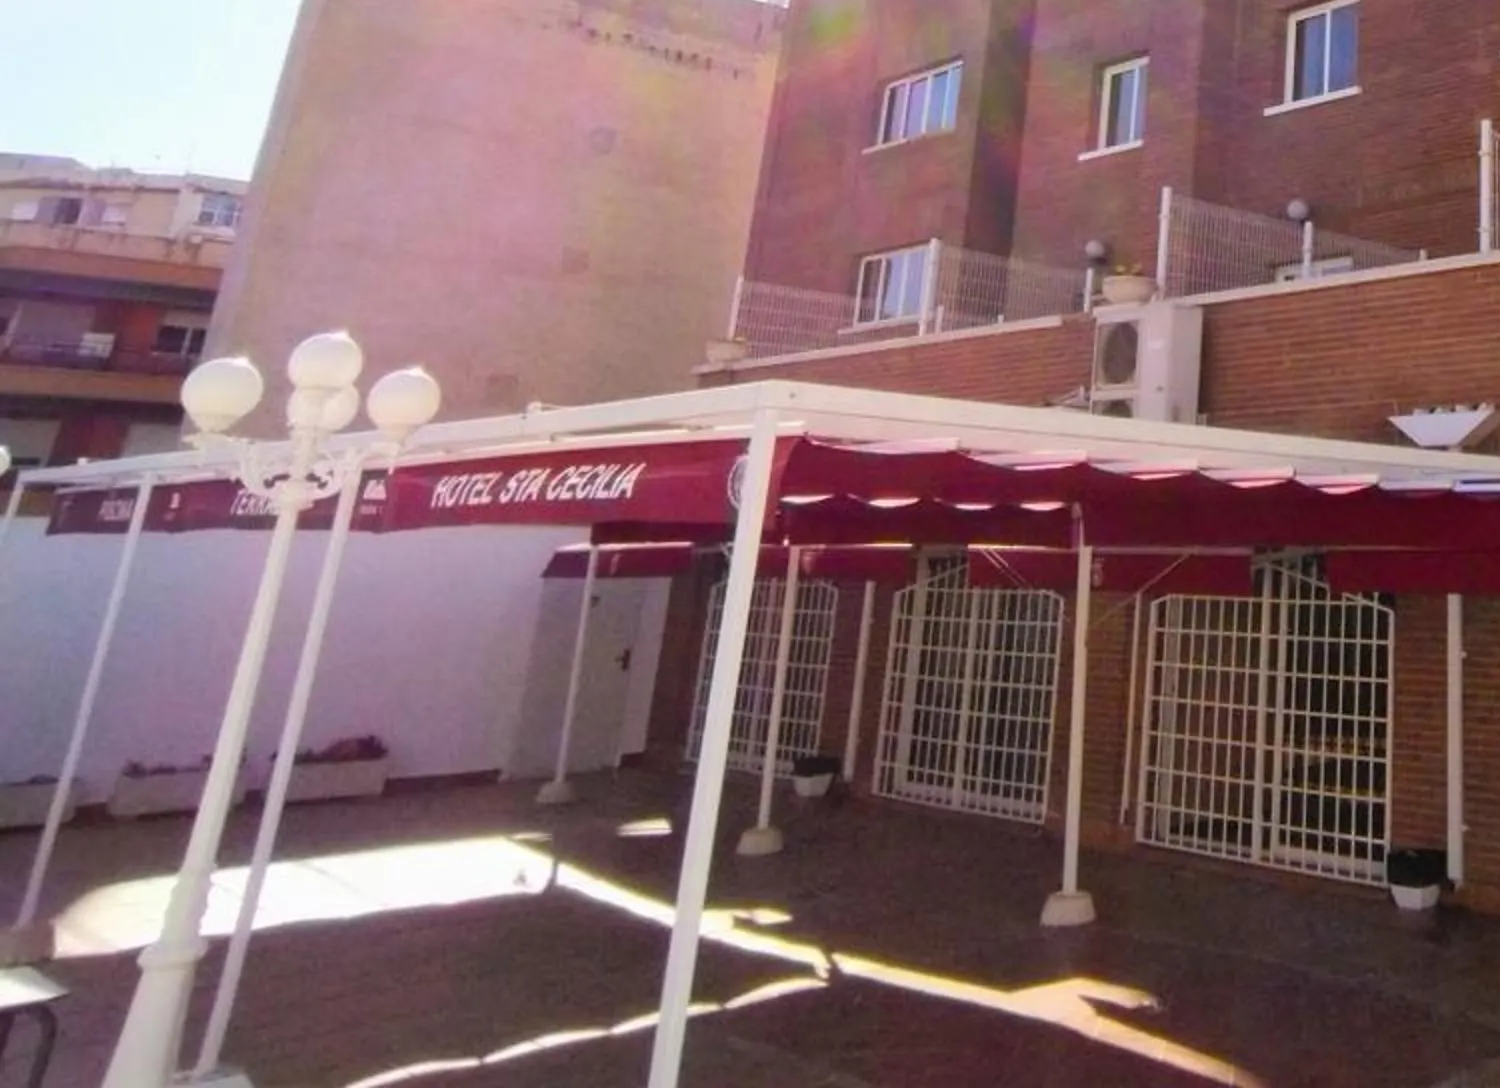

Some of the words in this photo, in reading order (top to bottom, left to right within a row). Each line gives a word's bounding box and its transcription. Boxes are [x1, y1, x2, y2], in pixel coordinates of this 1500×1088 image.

[431, 472, 503, 508] HOTEL
[499, 468, 551, 504] STA
[546, 463, 647, 501] CECILIA
